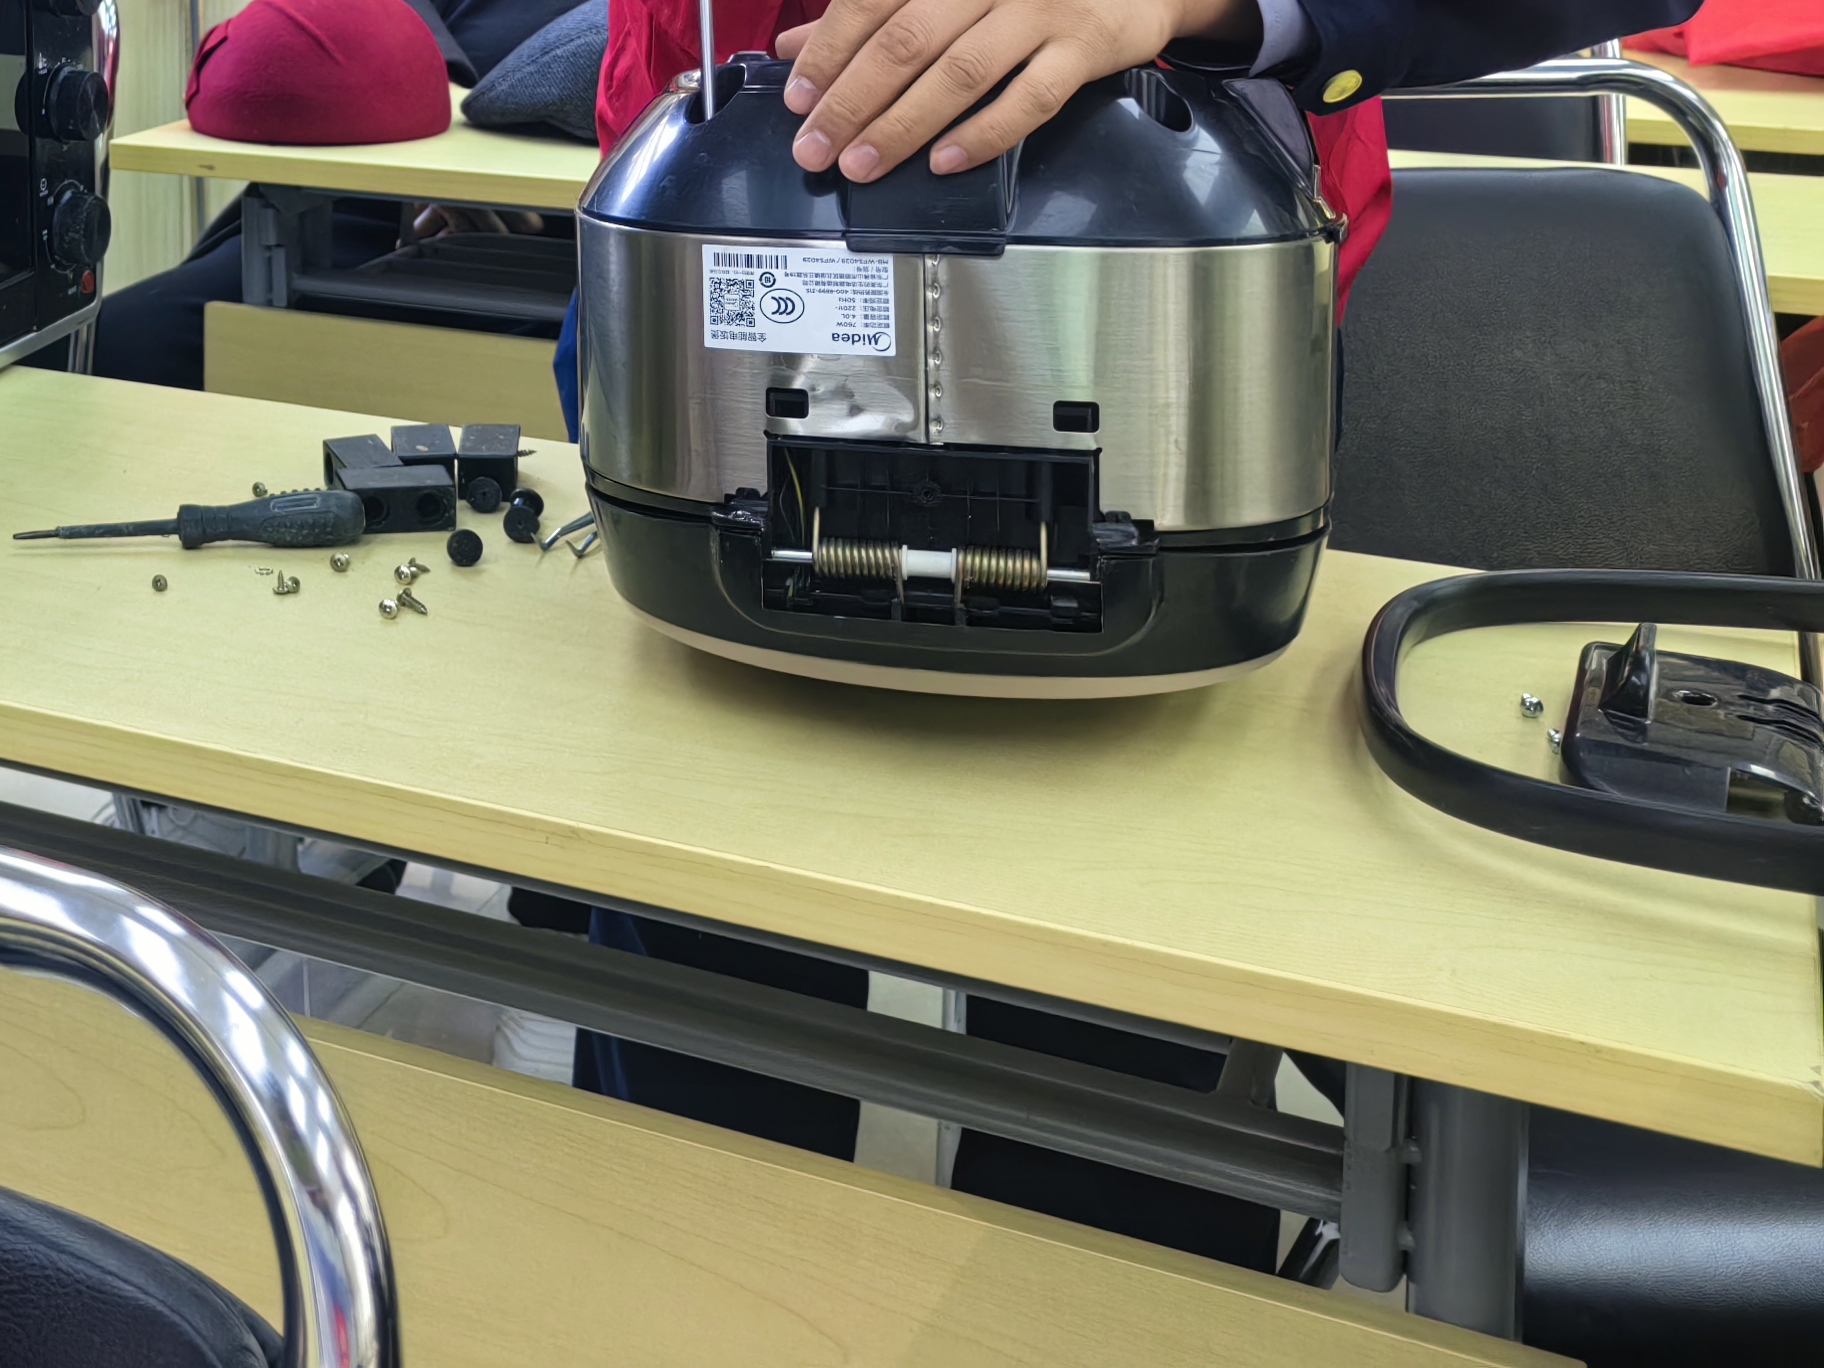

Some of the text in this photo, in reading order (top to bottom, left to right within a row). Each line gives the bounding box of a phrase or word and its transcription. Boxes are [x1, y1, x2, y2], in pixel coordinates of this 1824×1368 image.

[710, 329, 767, 343] 全智能电饭煲
[831, 331, 882, 347] Midea
